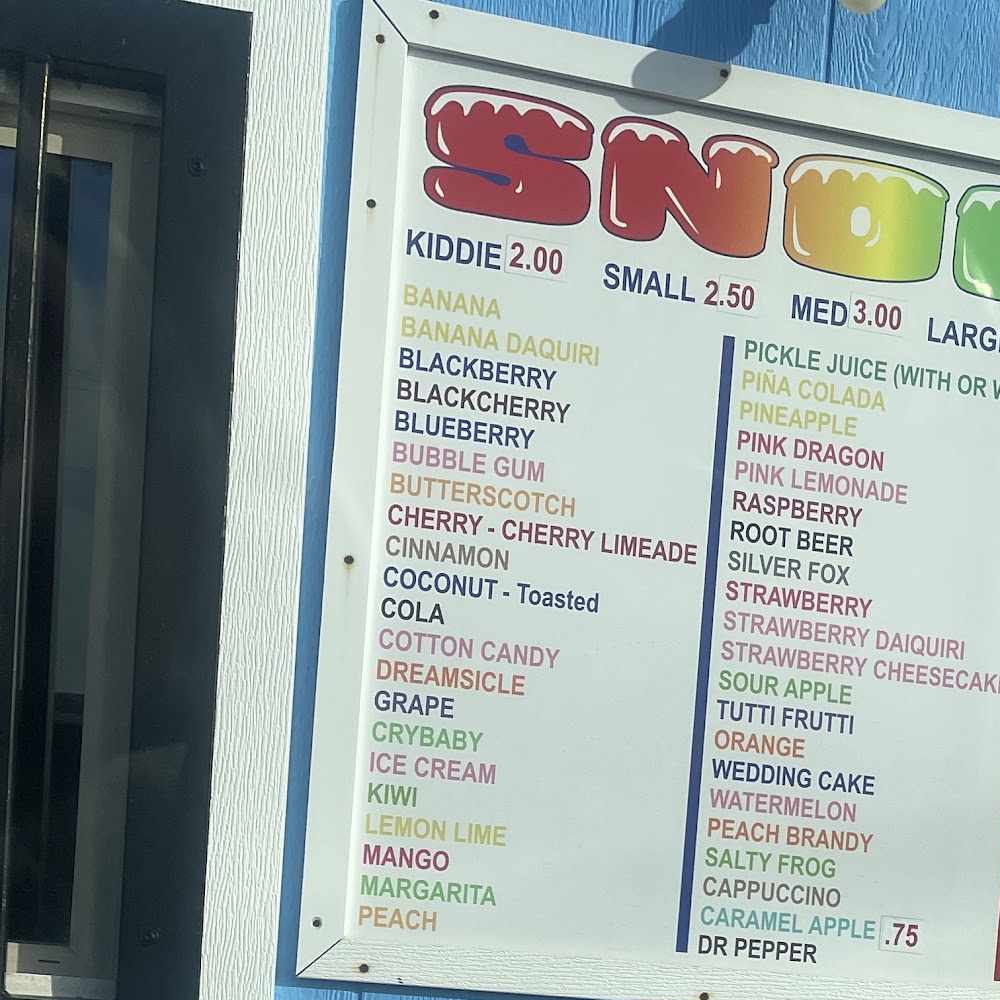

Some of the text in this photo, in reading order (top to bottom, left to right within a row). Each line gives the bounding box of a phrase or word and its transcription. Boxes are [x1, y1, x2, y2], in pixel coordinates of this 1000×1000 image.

[405, 228, 563, 275] KIDDIE 2.00
[602, 262, 755, 311] SMALL 2.50
[791, 293, 902, 331] MED 3.00
[398, 346, 557, 391] BLACKBERRY
[744, 339, 821, 371] PICKLE
[826, 353, 888, 382] JUICE
[893, 363, 951, 392] (WITH
[957, 373, 987, 398] OR
[396, 378, 571, 424] BLACKCHERRY
[741, 369, 886, 412] PIÑA COLADA
[394, 409, 535, 450] BLUEBERRY
[738, 399, 858, 437] PINEAPPLE
[392, 440, 545, 483] BUBBLE GUM
[737, 429, 884, 471] PINK DRAGON
[390, 472, 576, 518] BUTTERSCOTCH
[732, 489, 863, 528] RASPBERRY
[385, 534, 510, 571] CINNAMON
[387, 503, 697, 565] CHERRY CHERRY LIMEADE
[730, 519, 853, 557] ROOT BEER
[727, 549, 850, 586] SILVER FOX
[382, 565, 599, 613] COCONUT Toasted
[725, 579, 873, 618] STRAWBERRY
[380, 596, 445, 625] COLA
[375, 658, 526, 696] DREAMSICLE
[720, 639, 868, 677] STRAWBERRY
[373, 689, 454, 719] GRAPE
[718, 669, 853, 705] SOUR APPLE
[716, 698, 854, 735] TUTTI FRUTTI
[371, 720, 484, 753] CRYBABY
[713, 728, 805, 759] ORANGE
[368, 751, 496, 785] ICE CREAM
[711, 758, 876, 796] WEDDING CAKE
[367, 781, 418, 808] KIWI
[709, 787, 857, 823] WATERMELON
[707, 817, 874, 853] PEACH BRANDY
[362, 843, 450, 872] MANGO
[704, 846, 836, 879] SALTY FROG
[360, 874, 497, 907] MARGARITA
[700, 905, 918, 948] CARAMEL APPLE .75
[697, 934, 817, 964] DR PEPPER
